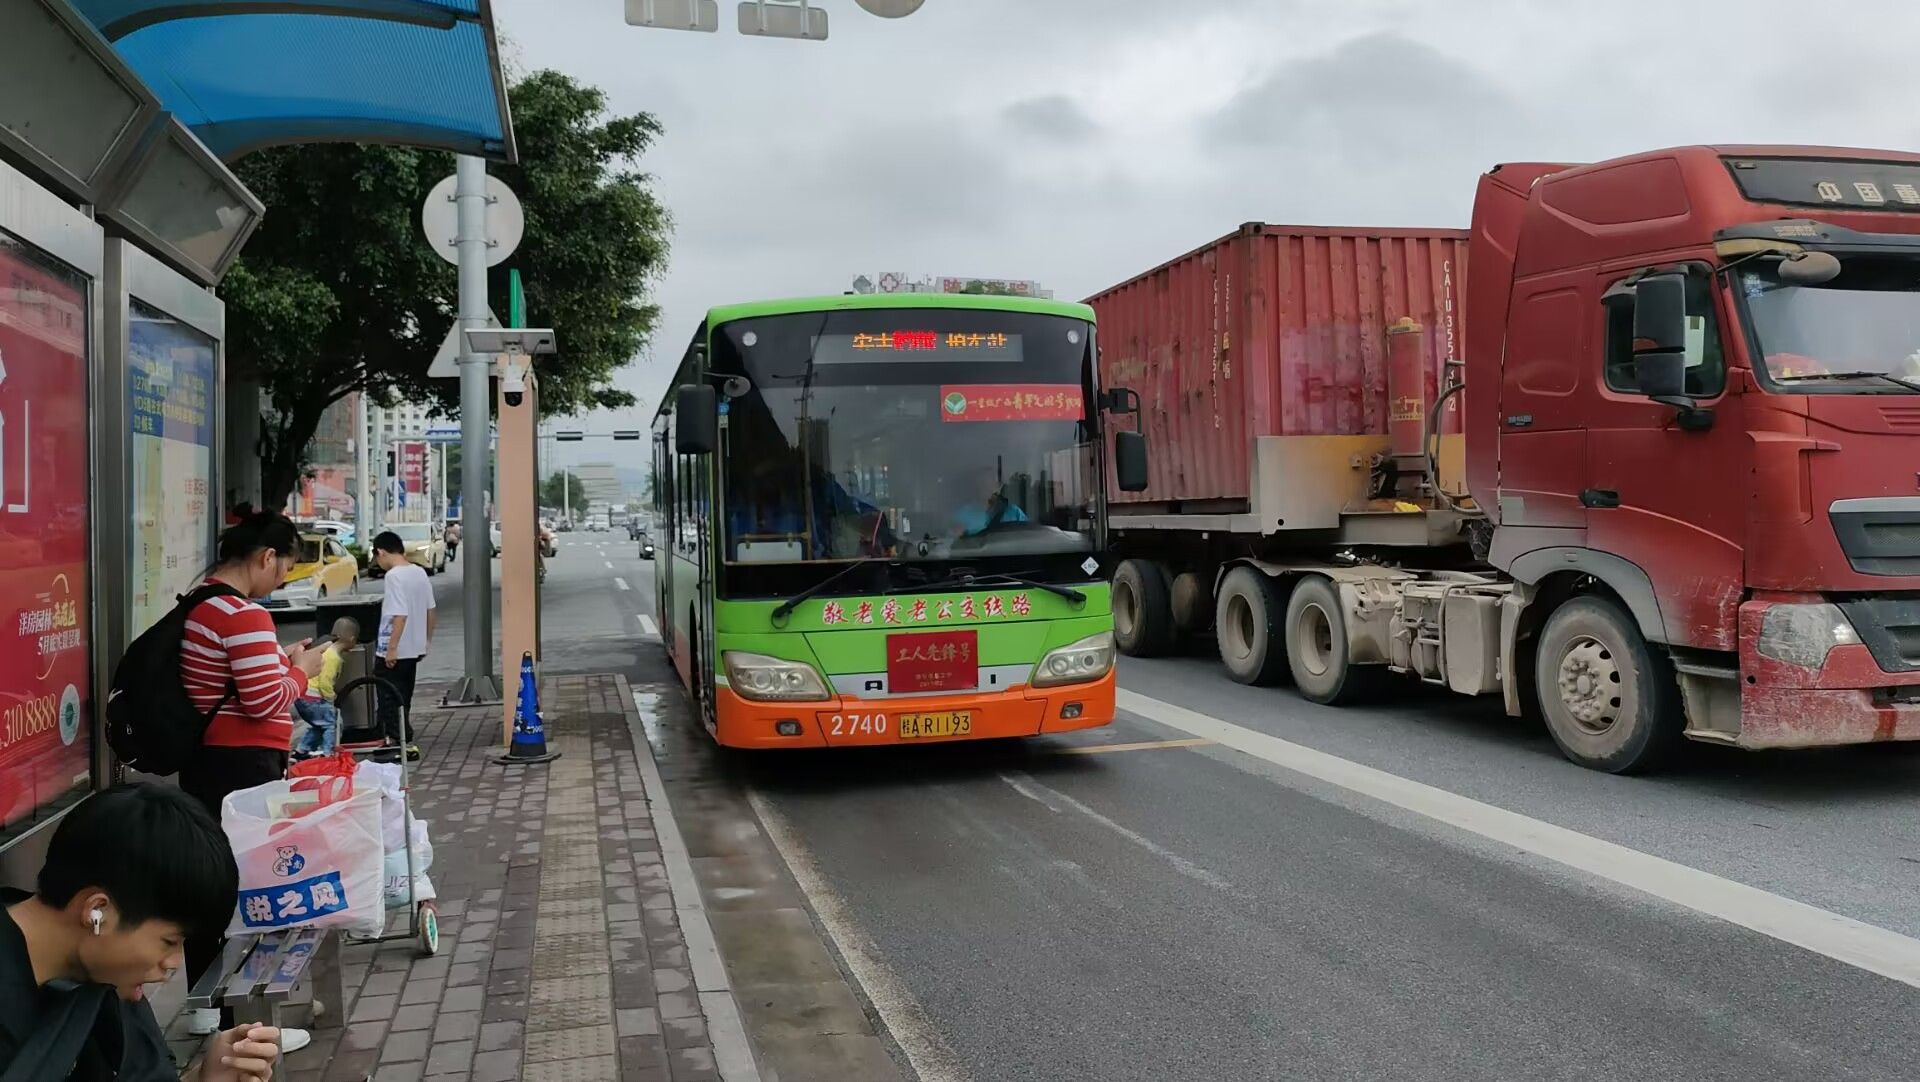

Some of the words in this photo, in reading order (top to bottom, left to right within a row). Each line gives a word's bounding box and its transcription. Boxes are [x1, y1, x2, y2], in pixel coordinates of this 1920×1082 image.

[1446, 315, 1455, 389] 35531
[823, 593, 1031, 625] 敬老爱老公交线路
[0, 703, 24, 750] 310
[25, 693, 57, 737] 8888
[831, 713, 887, 736] 2740
